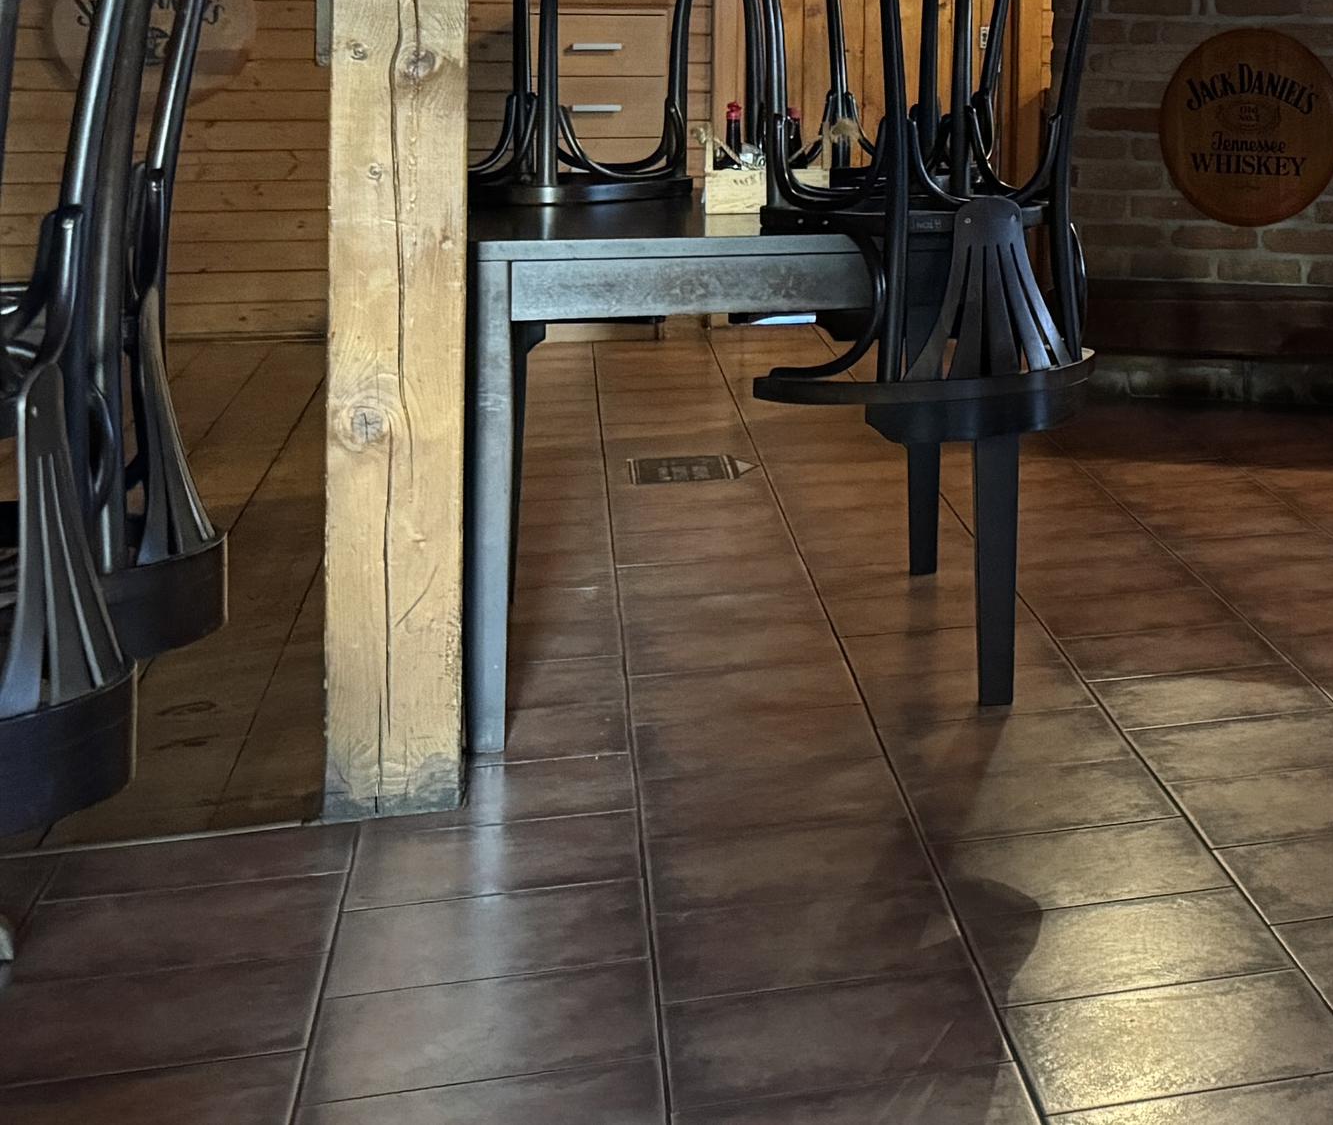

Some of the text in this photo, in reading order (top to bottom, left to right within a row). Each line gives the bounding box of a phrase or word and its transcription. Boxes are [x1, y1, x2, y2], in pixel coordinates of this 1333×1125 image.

[1185, 63, 1320, 116] JACK DANIEL'S
[1210, 130, 1288, 153] Tennessee
[1190, 152, 1308, 177] WHISKEY
